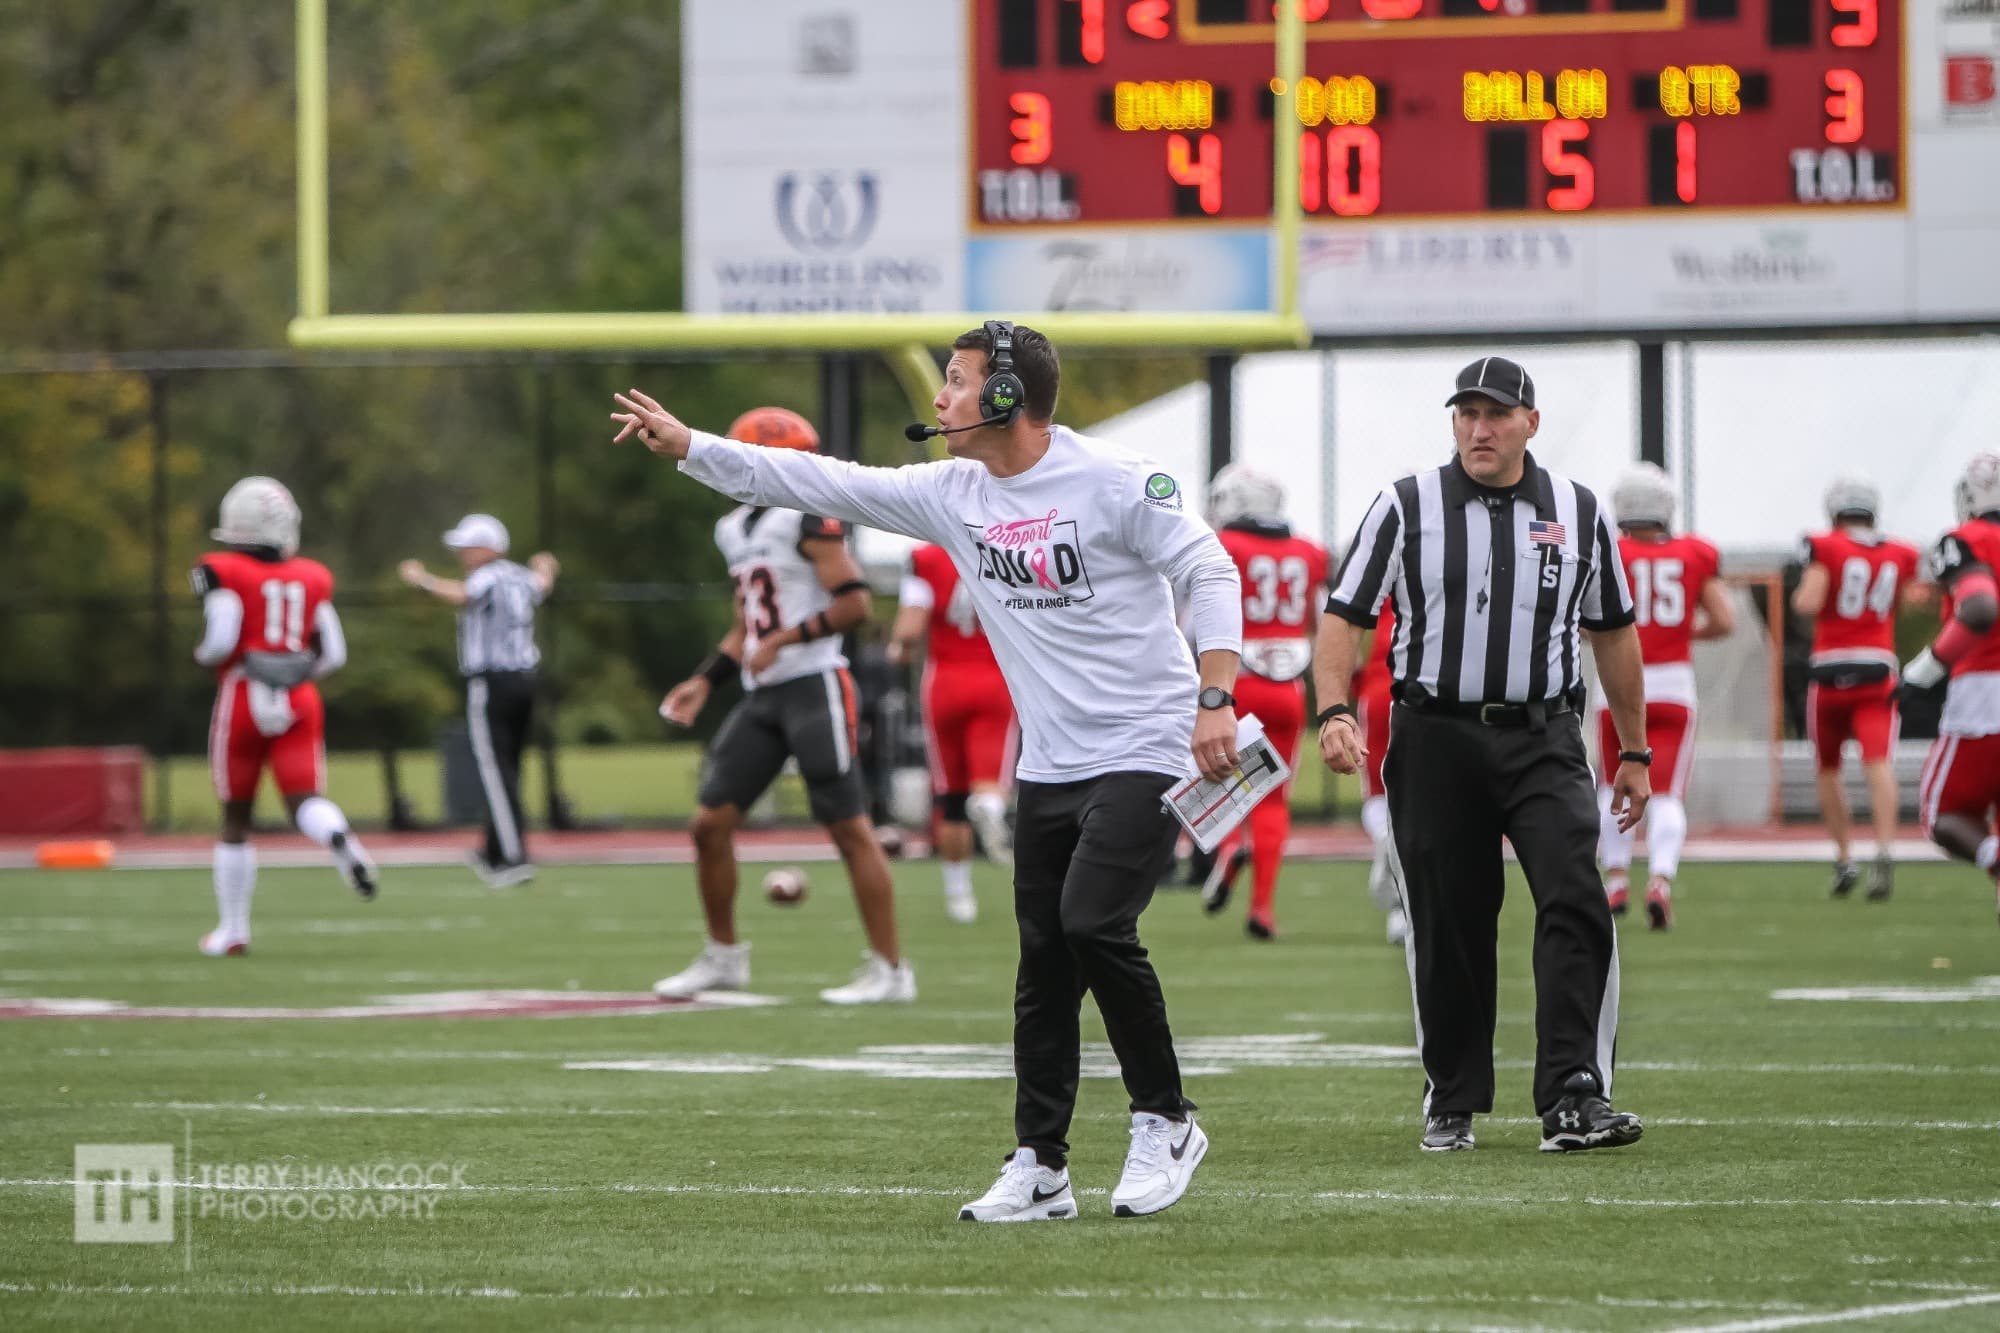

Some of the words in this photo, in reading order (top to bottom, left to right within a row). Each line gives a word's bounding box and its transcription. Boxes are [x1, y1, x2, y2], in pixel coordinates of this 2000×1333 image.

[1010, 92, 1052, 164] 3
[1825, 69, 1864, 143] 3
[1168, 134, 1222, 214] 4
[1300, 126, 1381, 215] 10
[1542, 119, 1595, 211] 5
[1676, 121, 1697, 202] 1
[984, 509, 1058, 550] Support
[1004, 597, 1034, 611] #TEAM
[1036, 596, 1071, 609] RANGE
[1246, 553, 1309, 628] 33
[1542, 564, 1559, 588] S
[1632, 556, 1687, 629] 15
[261, 577, 307, 653] 11
